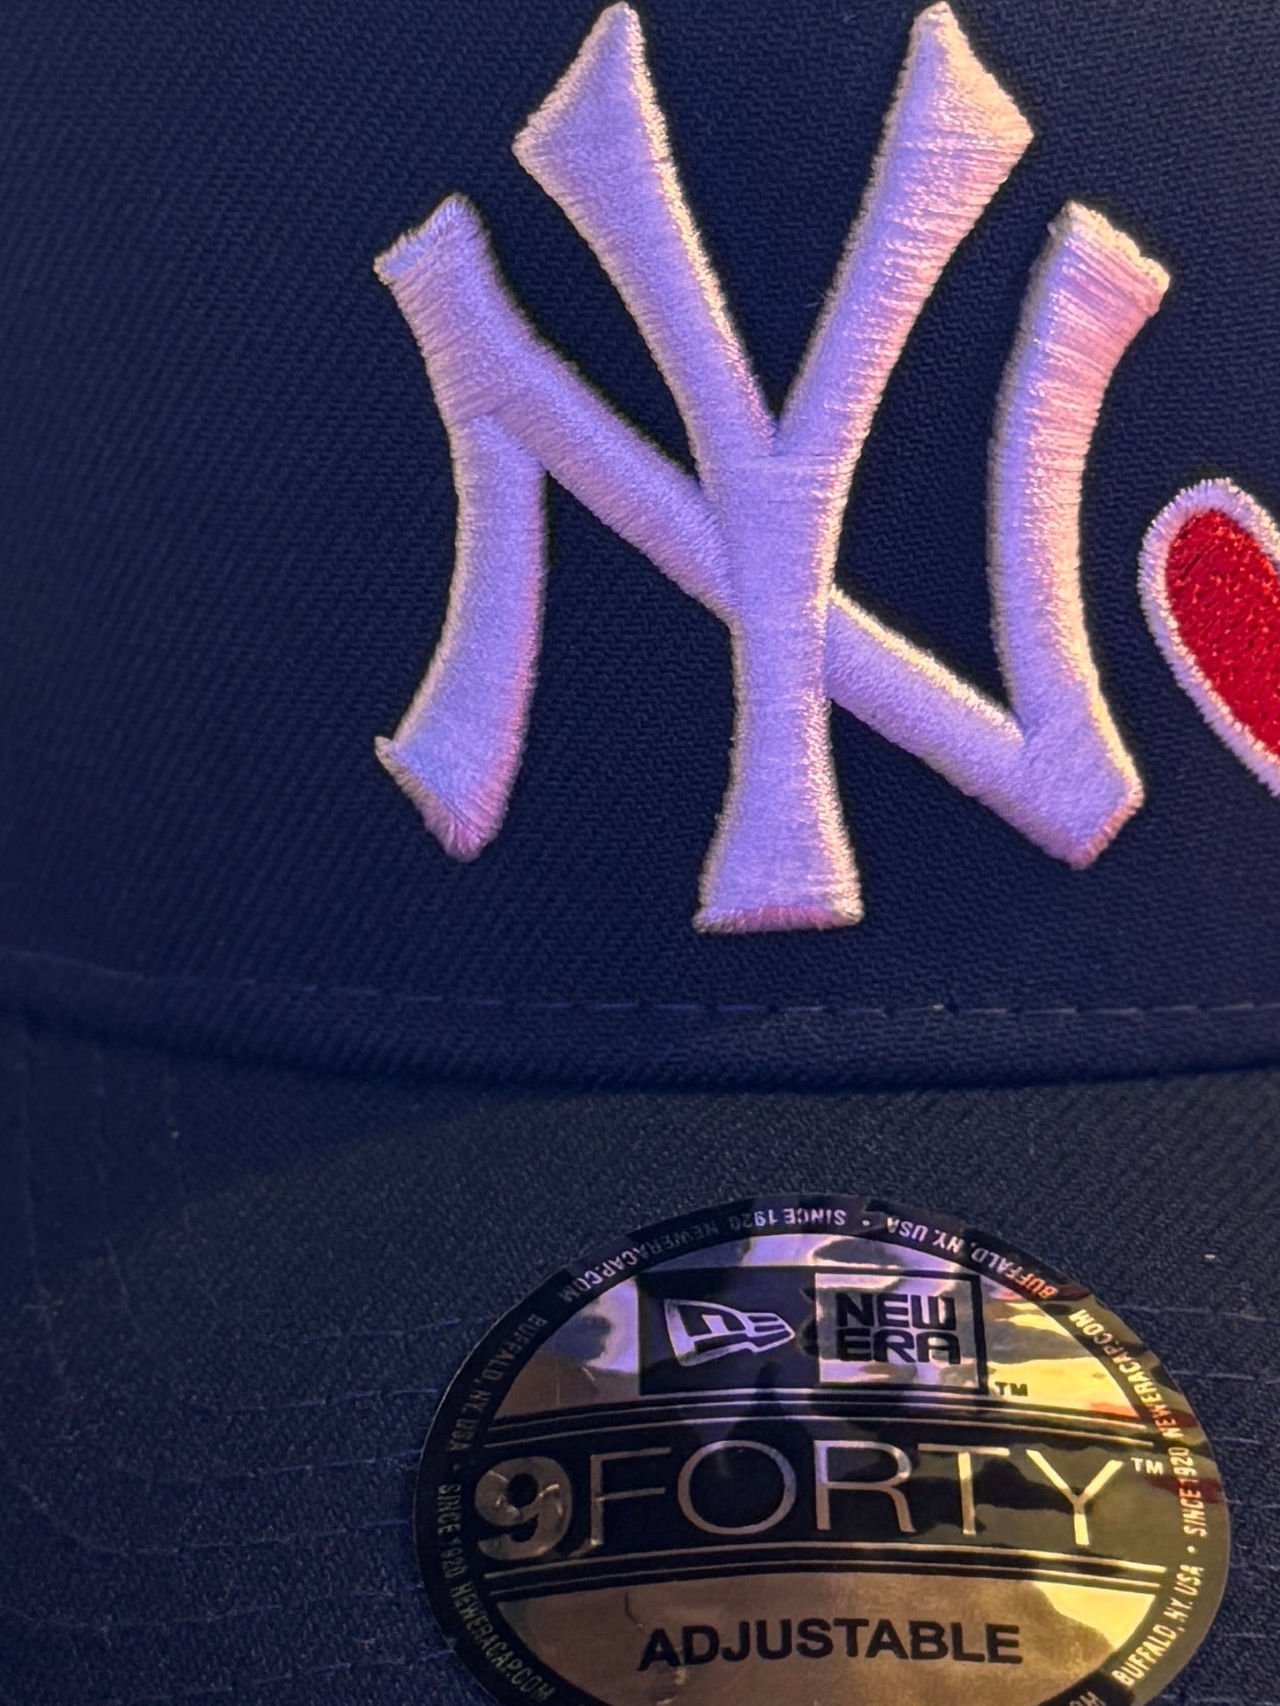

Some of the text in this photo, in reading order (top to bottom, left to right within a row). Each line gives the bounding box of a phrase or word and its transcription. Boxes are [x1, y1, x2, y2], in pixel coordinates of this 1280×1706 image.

[374, 1, 1171, 933] NY
[728, 1210, 779, 1231] 1920
[783, 1207, 847, 1228] SINCE
[884, 1216, 927, 1243] USA
[836, 1293, 956, 1330] NEW
[836, 1330, 961, 1365] ERA
[1067, 1309, 1185, 1439] NEWERACAP.COM
[446, 1418, 480, 1452] USA
[1167, 1446, 1199, 1487] 1920
[437, 1483, 462, 1535] SINCE
[475, 1439, 1123, 1561] 9FORTY
[1179, 1488, 1208, 1537] SINCE
[1173, 1564, 1205, 1597] USA
[638, 1618, 1023, 1672] ADJUSTABLE
